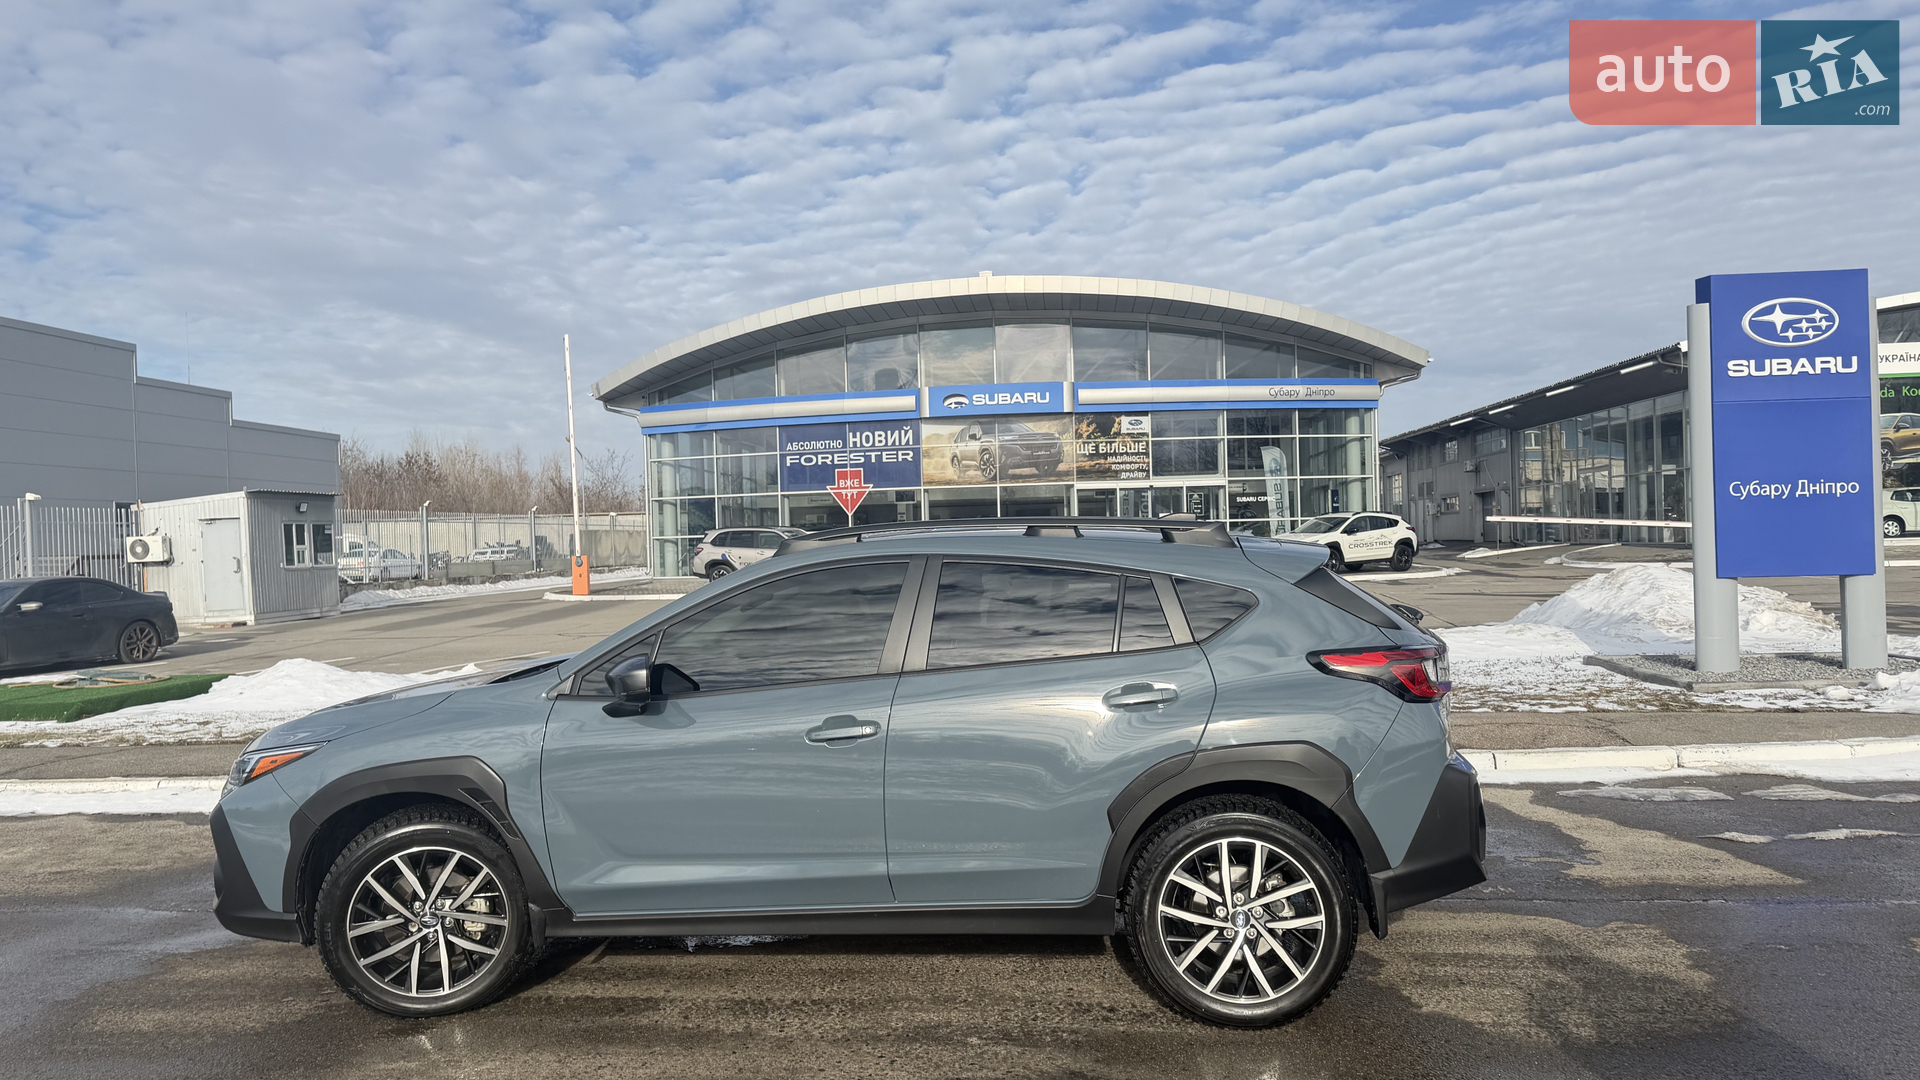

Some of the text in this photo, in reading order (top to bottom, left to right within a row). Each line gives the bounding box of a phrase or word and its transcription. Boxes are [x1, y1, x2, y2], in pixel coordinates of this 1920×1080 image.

[1727, 356, 1858, 377] SUBARU
[972, 392, 1050, 406] SUBARU
[1268, 387, 1336, 398] Субару Дніпро
[786, 425, 914, 451] АБСОЛЮТНО НОВИЙ
[1076, 442, 1147, 455] ЩЕ БІЛЬШЕ
[786, 450, 914, 467] FORESTER
[1121, 470, 1147, 479] ДРАЙВУ
[839, 479, 860, 488] ВЖЕ
[1729, 479, 1860, 500] Субару Дніпро
[841, 491, 858, 500] ТУТ
[1348, 540, 1394, 549] CROSSTREK
